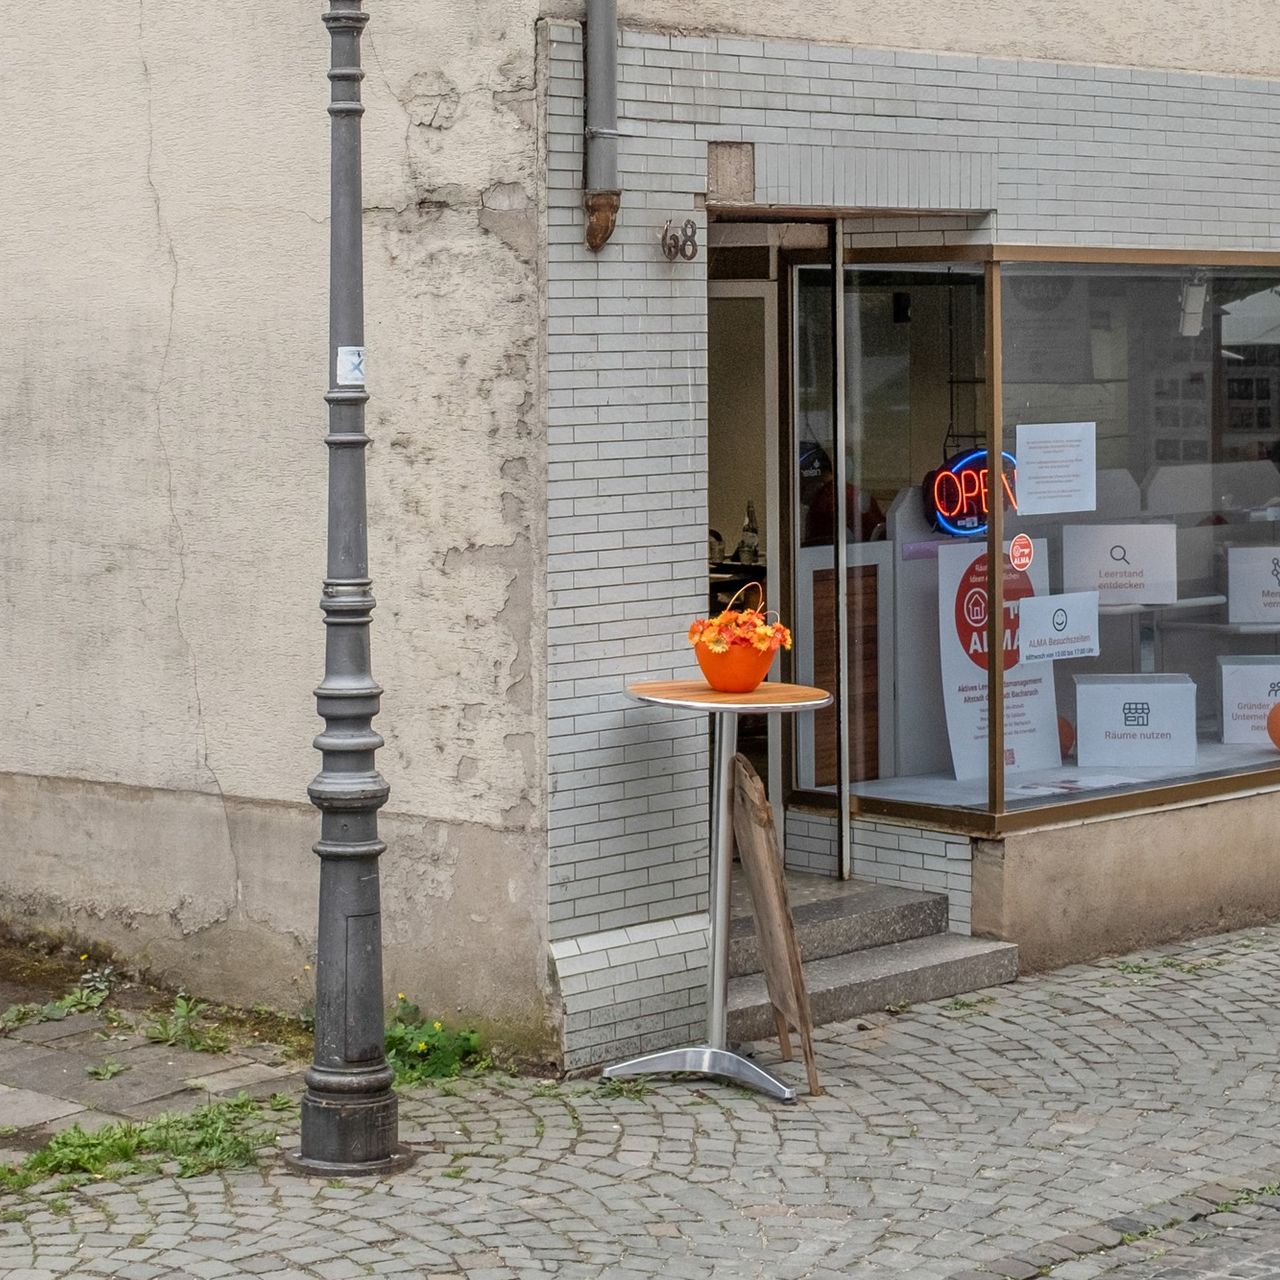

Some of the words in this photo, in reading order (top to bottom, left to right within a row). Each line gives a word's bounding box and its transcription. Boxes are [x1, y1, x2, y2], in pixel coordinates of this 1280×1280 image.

[661, 219, 698, 261] 68
[1013, 556, 1030, 565] ALMA
[1099, 570, 1144, 578] Leerstand
[1098, 581, 1145, 589] entdecken
[1104, 731, 1138, 739] Räume
